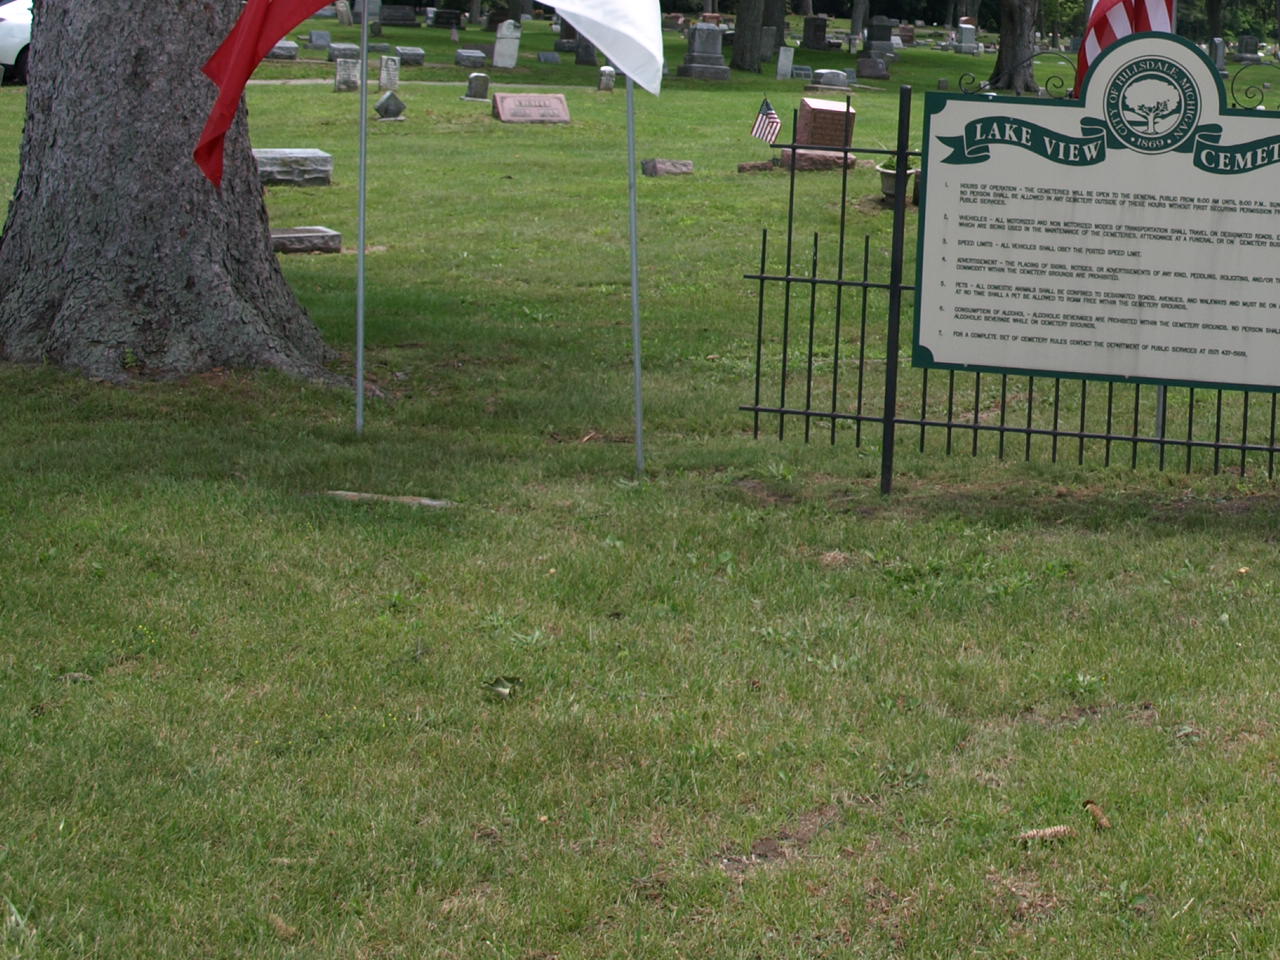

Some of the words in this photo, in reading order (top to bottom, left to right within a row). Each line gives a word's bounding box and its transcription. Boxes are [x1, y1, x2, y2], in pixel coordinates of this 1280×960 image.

[1109, 87, 1119, 104] OF
[1174, 78, 1196, 138] MICHIGAN
[1108, 108, 1128, 136] CITY
[975, 122, 1032, 146] LAKE
[1043, 136, 1101, 161] VIEW
[1137, 138, 1164, 149] 1869
